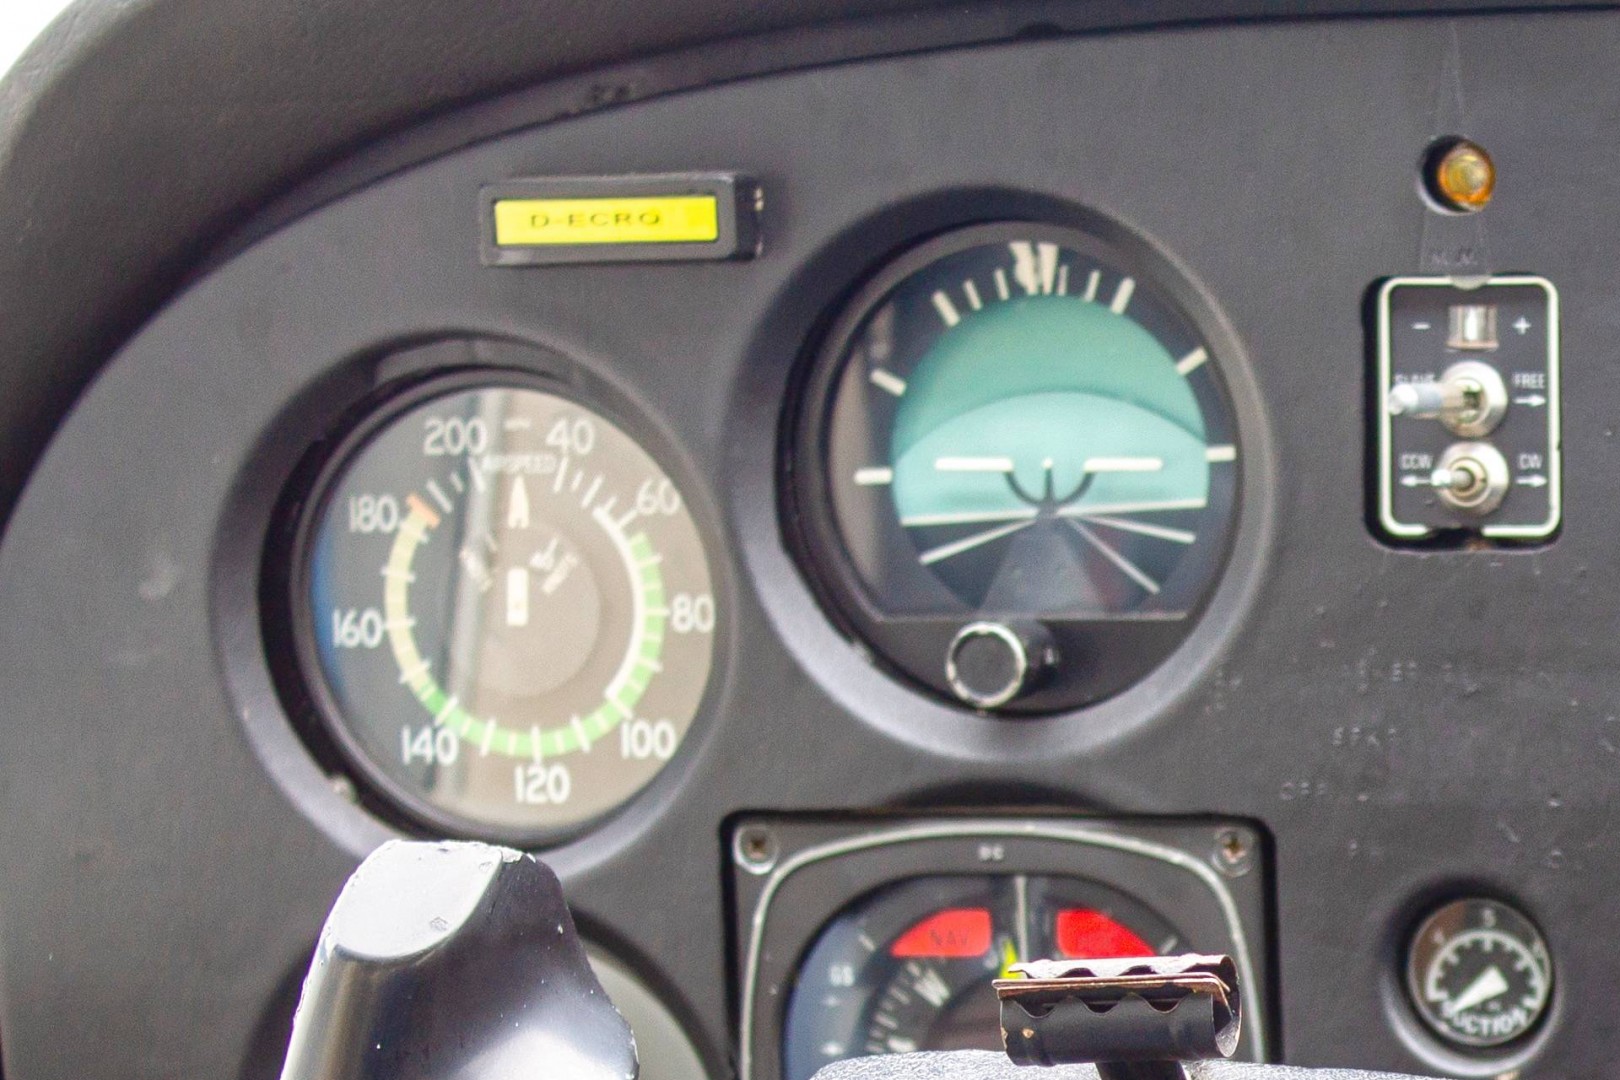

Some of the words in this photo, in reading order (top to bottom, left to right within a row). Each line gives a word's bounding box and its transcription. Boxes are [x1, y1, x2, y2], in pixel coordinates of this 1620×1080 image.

[424, 419, 487, 456] 200
[546, 419, 595, 454] 40
[348, 495, 399, 533] 180
[636, 478, 681, 515] 60
[332, 610, 384, 648] 160
[671, 598, 716, 633] 80
[401, 725, 459, 765] 140
[620, 721, 677, 758] 100
[514, 766, 572, 804] 120
